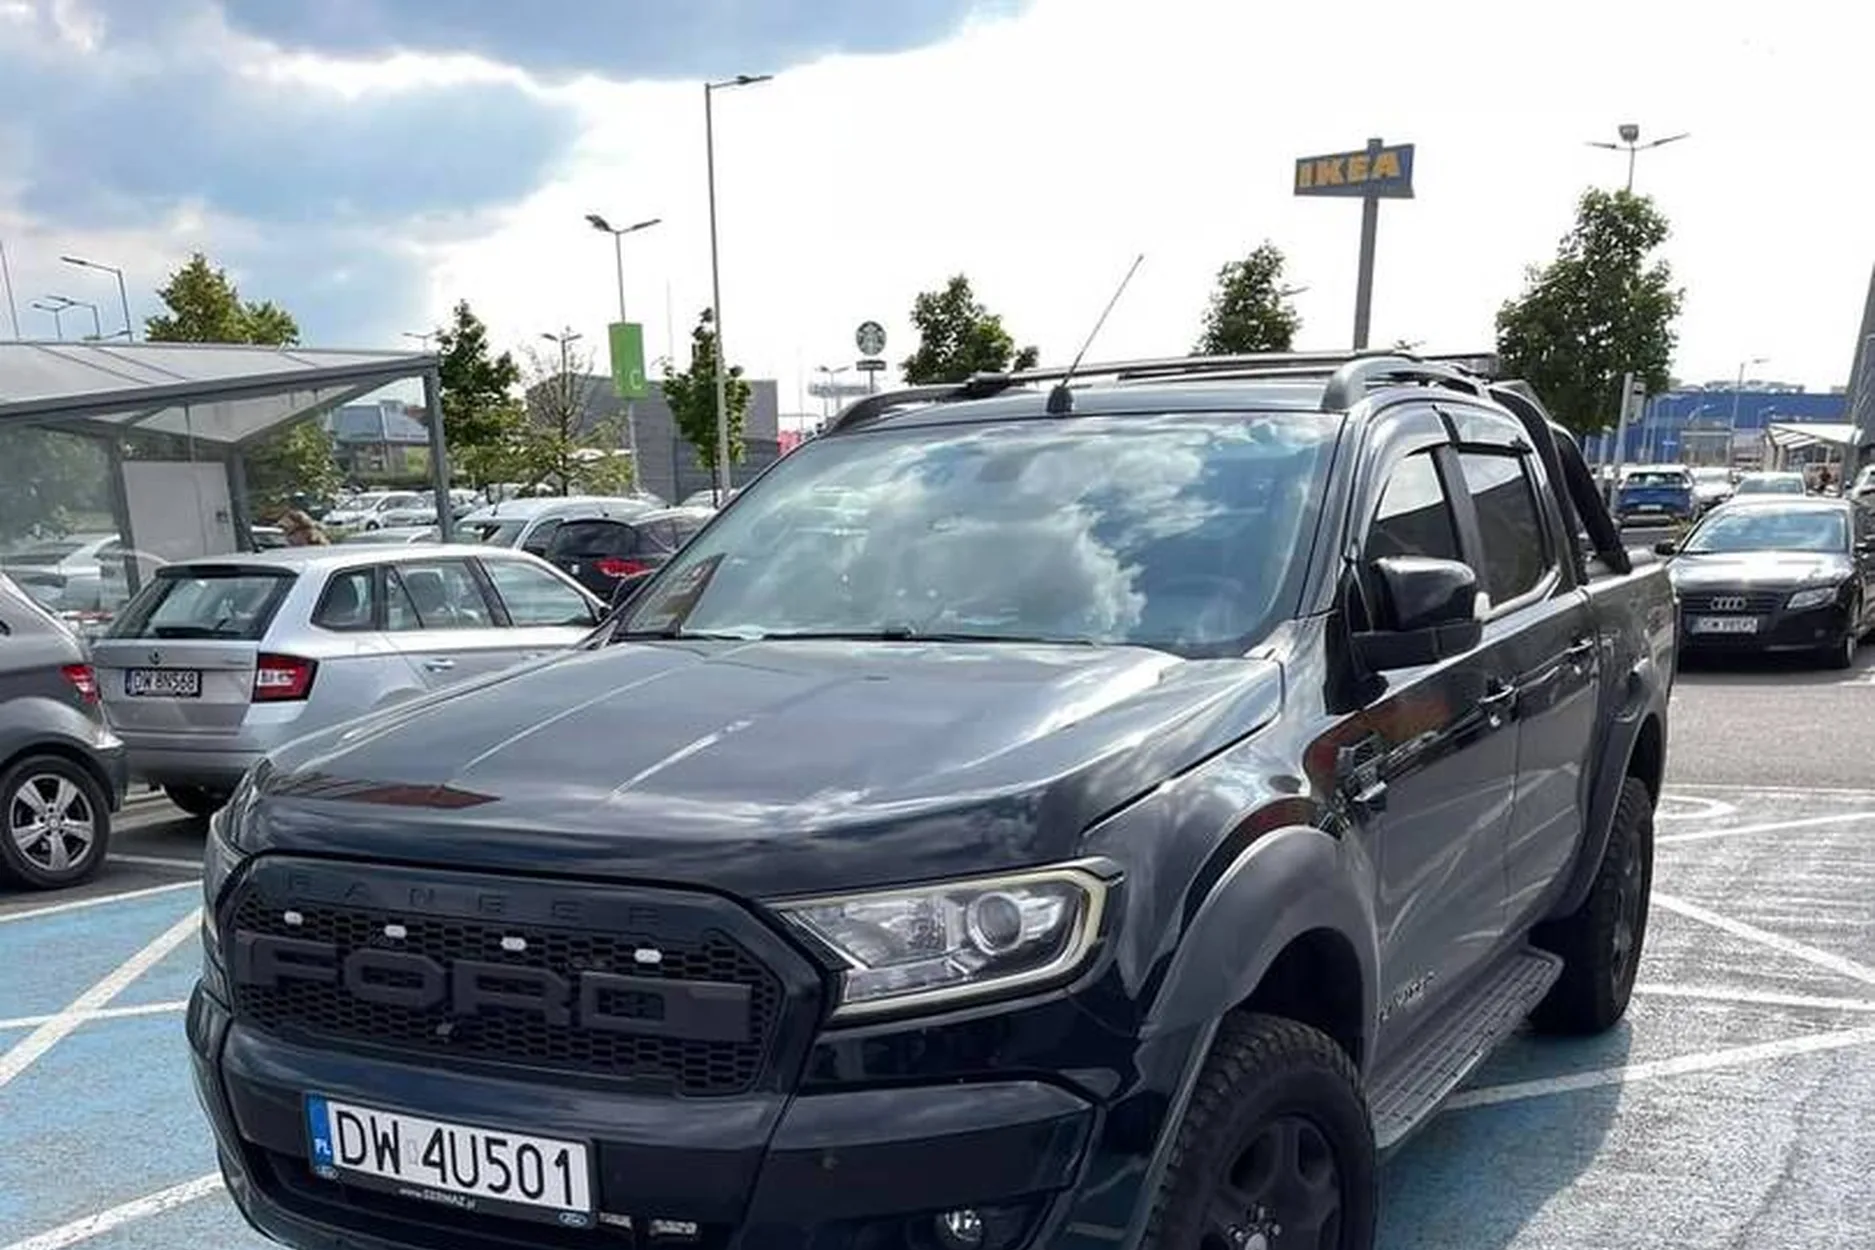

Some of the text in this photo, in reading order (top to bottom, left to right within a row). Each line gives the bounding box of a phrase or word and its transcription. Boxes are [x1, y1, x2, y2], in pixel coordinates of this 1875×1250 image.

[1298, 151, 1401, 188] IKEA
[288, 873, 662, 926] RANGER
[235, 930, 753, 1042] FORD
[314, 1137, 331, 1156] PL
[336, 1110, 574, 1206] DW 4U501
